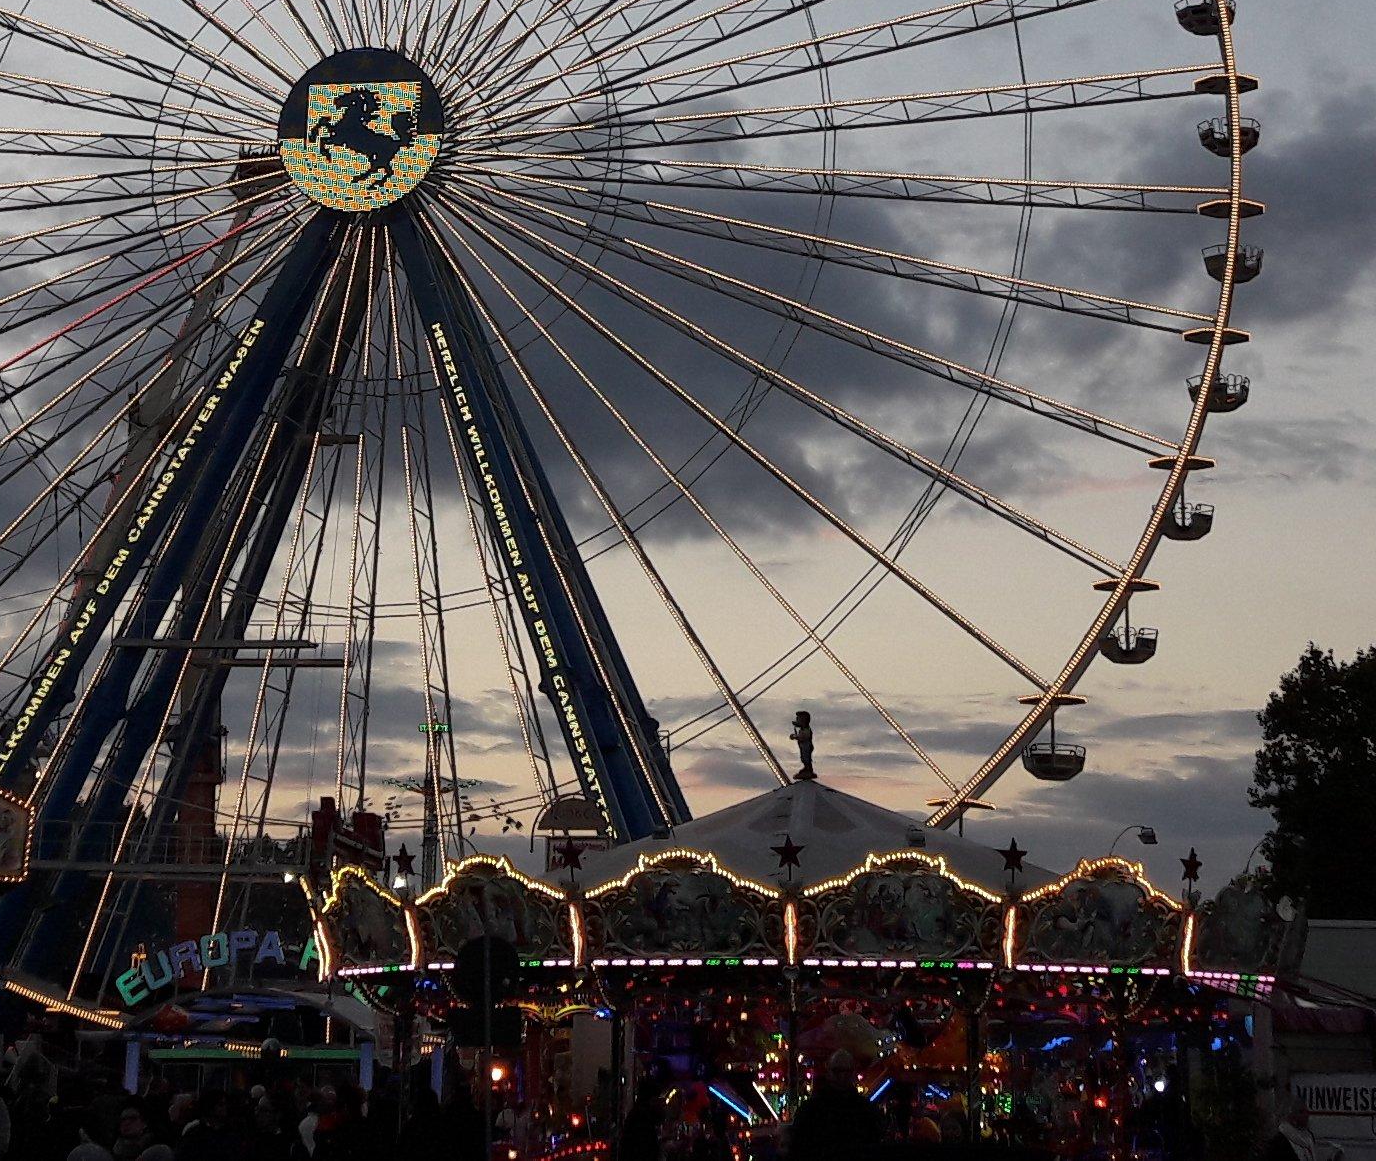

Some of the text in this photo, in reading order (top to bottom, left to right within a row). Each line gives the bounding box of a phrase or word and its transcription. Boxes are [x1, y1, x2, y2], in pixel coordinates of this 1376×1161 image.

[69, 597, 99, 646] AUF
[96, 547, 131, 596] DEM
[127, 393, 222, 544] CANNSTATTER
[215, 318, 267, 390] WASEN
[431, 321, 473, 422] HERZLICH
[466, 424, 523, 567] WILLKOMMEN
[516, 572, 540, 614] AUF
[533, 619, 559, 668] DEM
